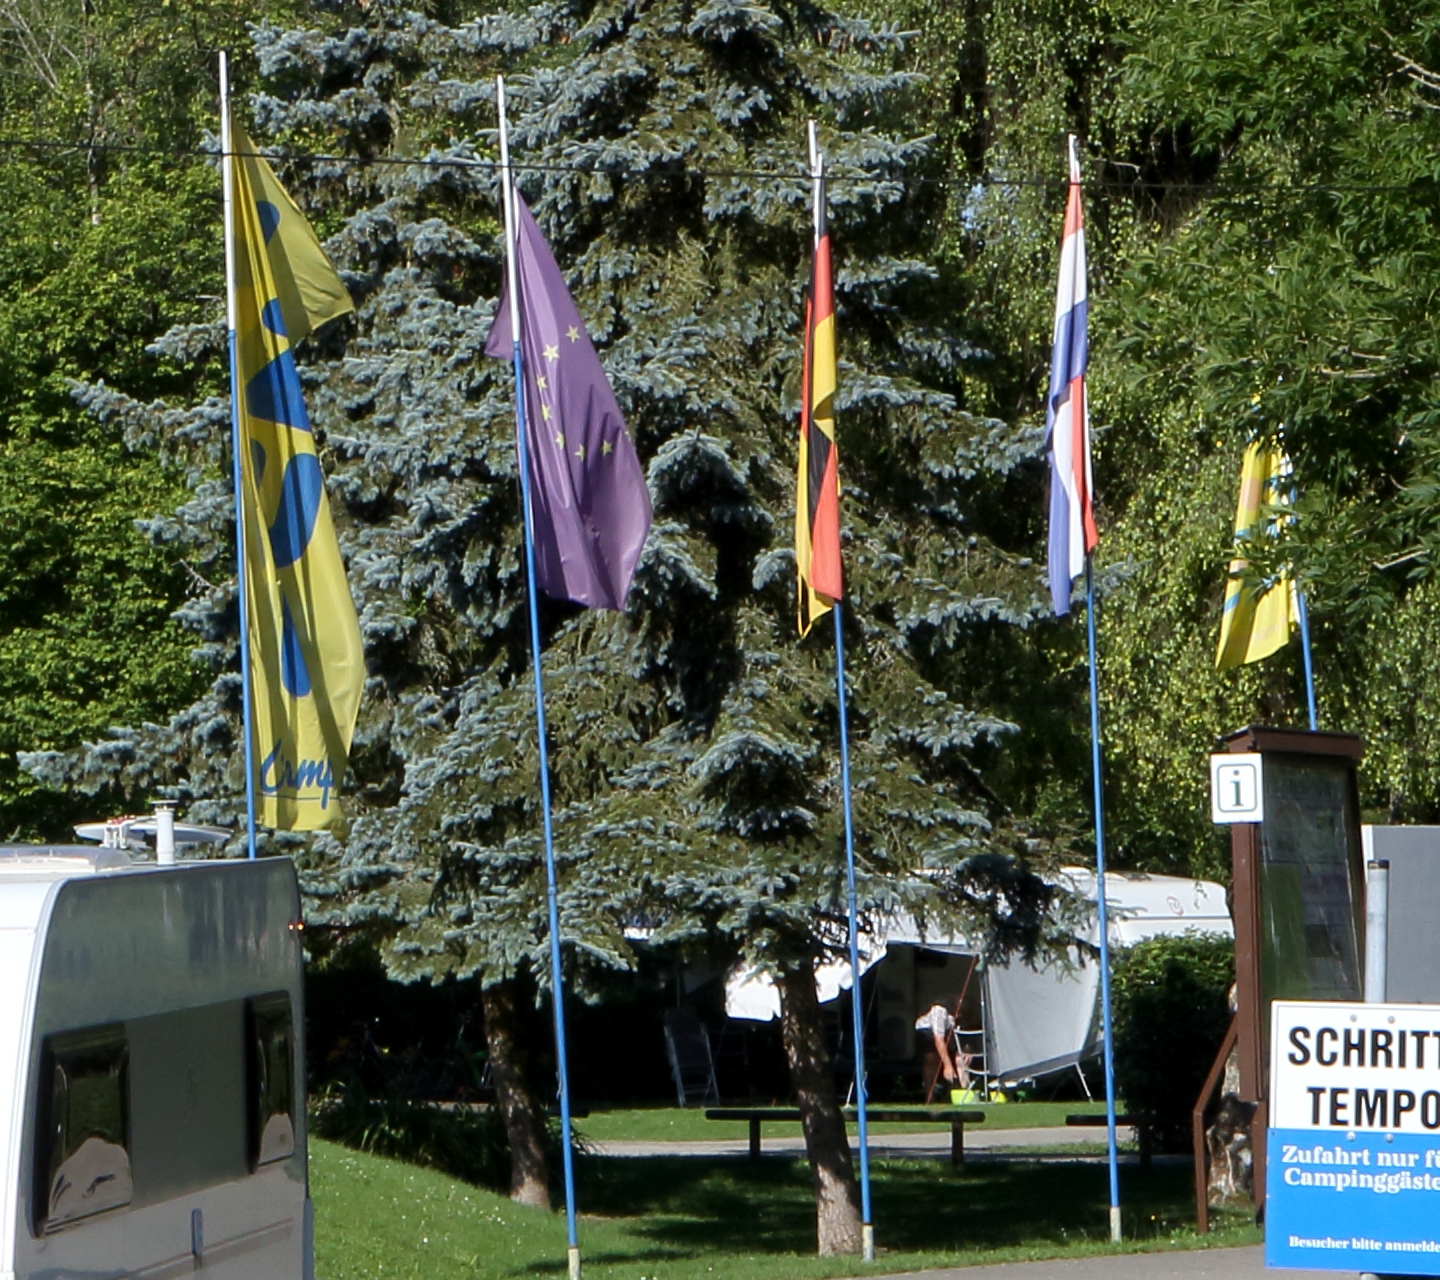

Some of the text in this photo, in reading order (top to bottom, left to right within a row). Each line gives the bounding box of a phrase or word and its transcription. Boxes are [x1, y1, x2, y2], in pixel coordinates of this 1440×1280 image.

[1281, 1144, 1371, 1167] Zufahrt
[1376, 1150, 1420, 1168] nur
[1288, 1234, 1350, 1250] Besucher
[1351, 1237, 1383, 1251] bitte
